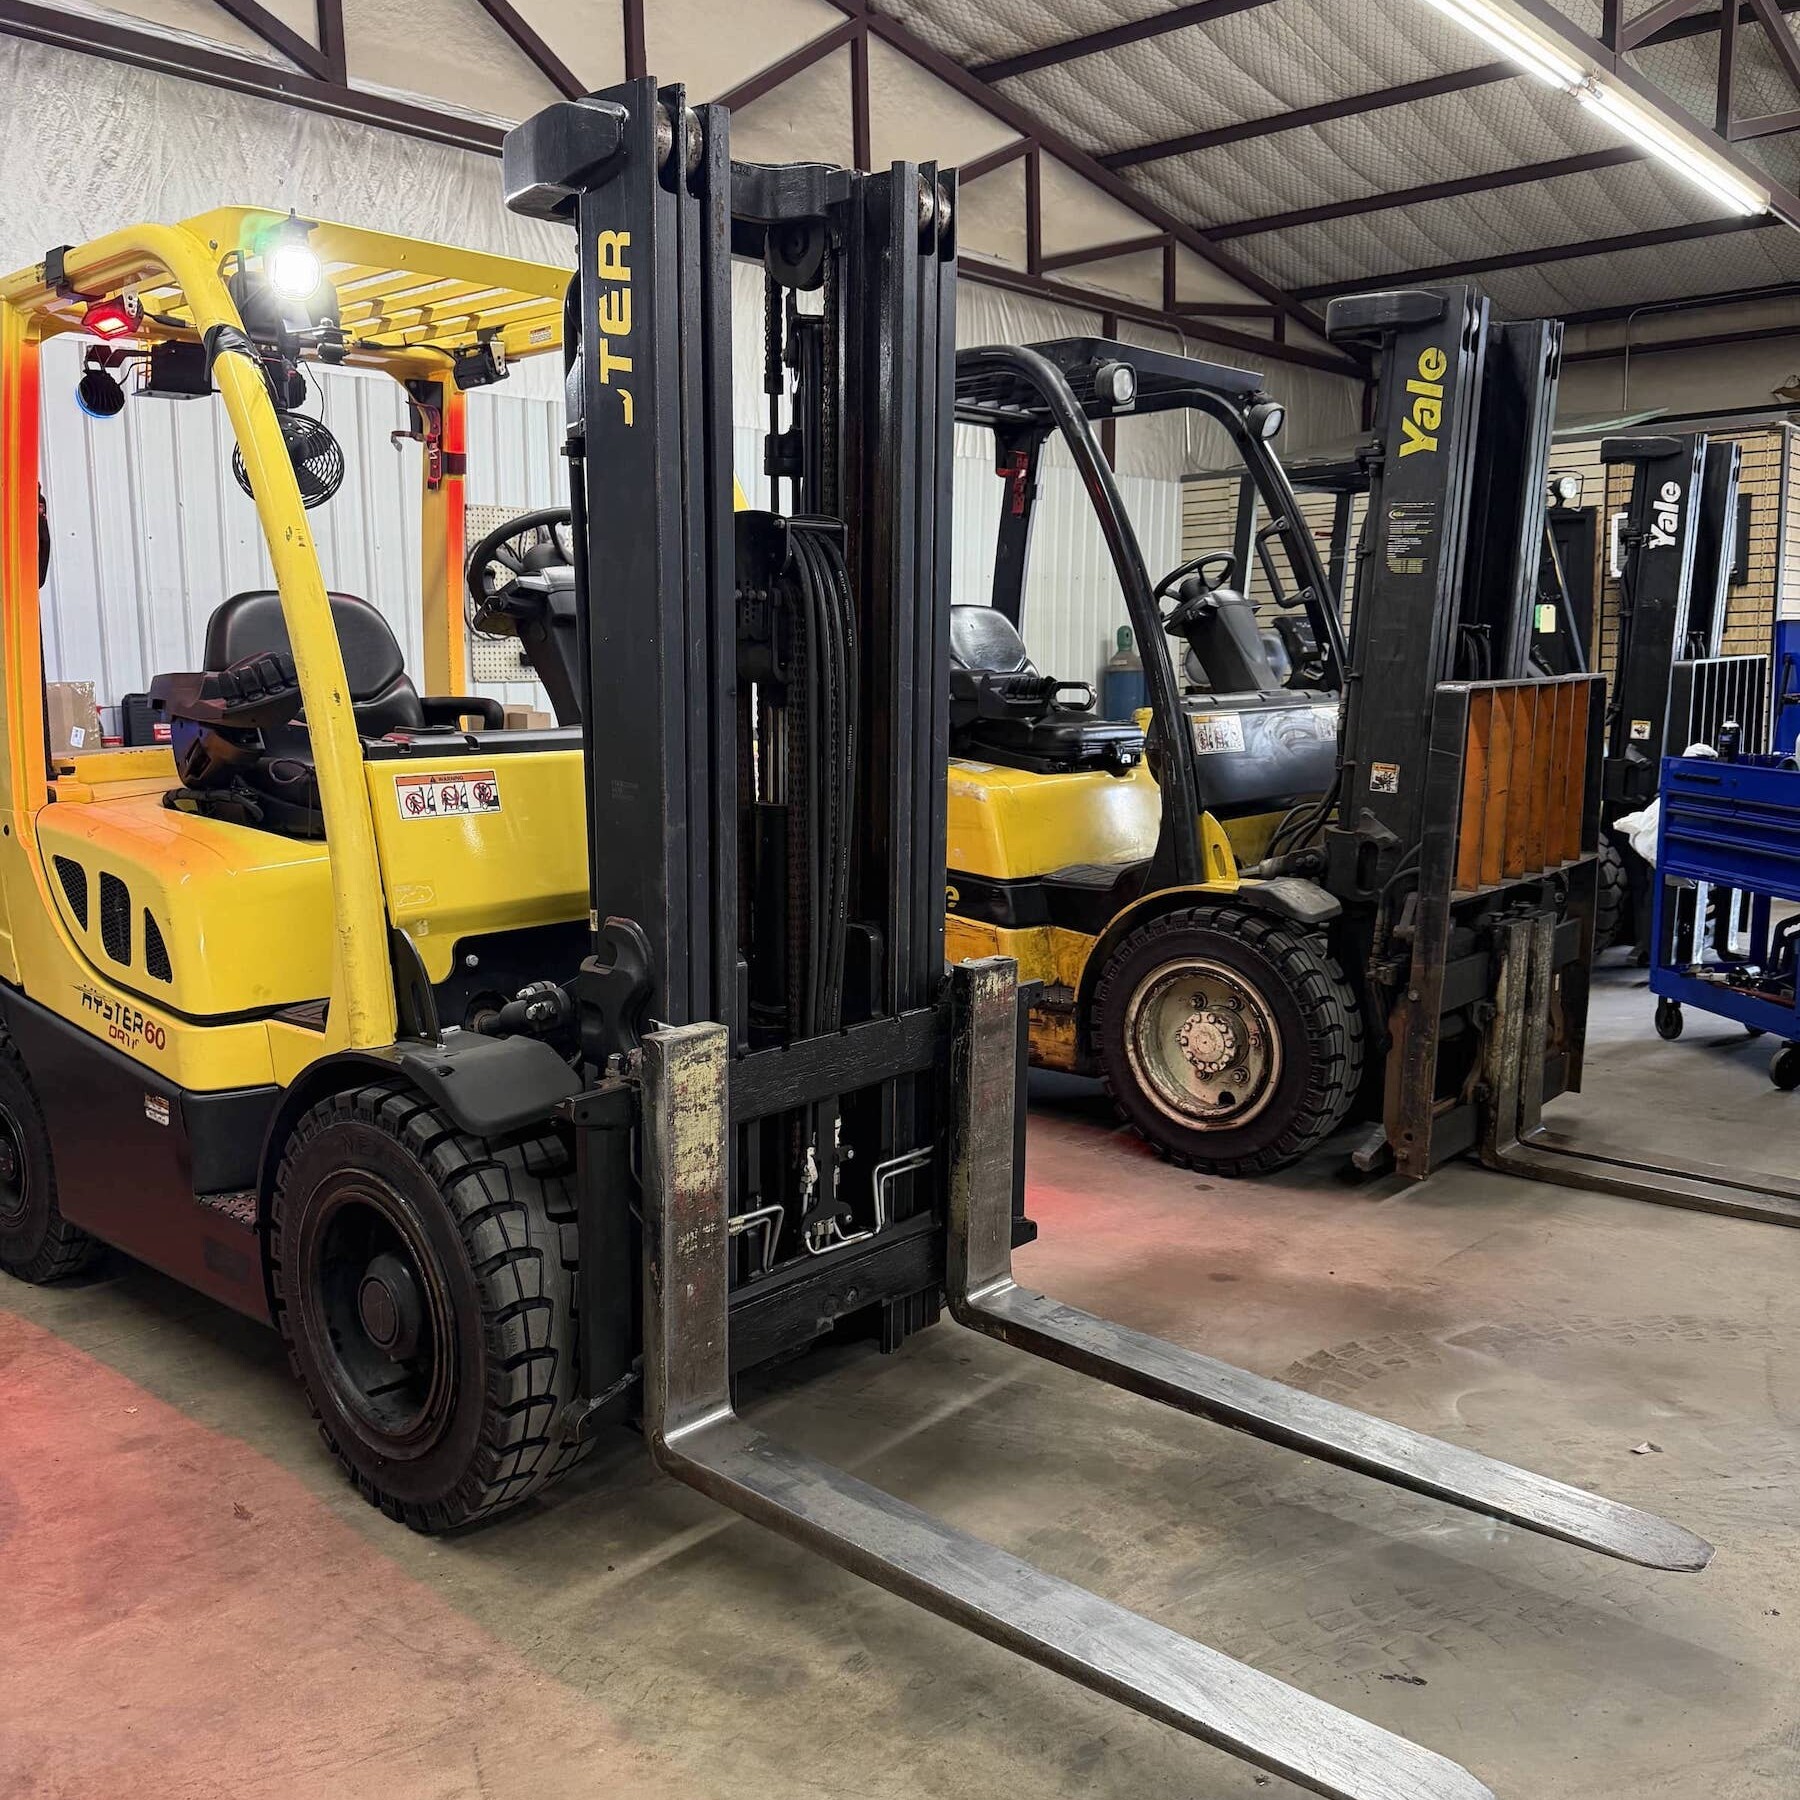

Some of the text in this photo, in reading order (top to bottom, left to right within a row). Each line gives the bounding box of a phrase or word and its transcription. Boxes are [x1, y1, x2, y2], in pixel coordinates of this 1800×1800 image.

[1399, 347, 1447, 458] Yale
[1648, 481, 1681, 549] Yale
[145, 1020, 165, 1050] 60
